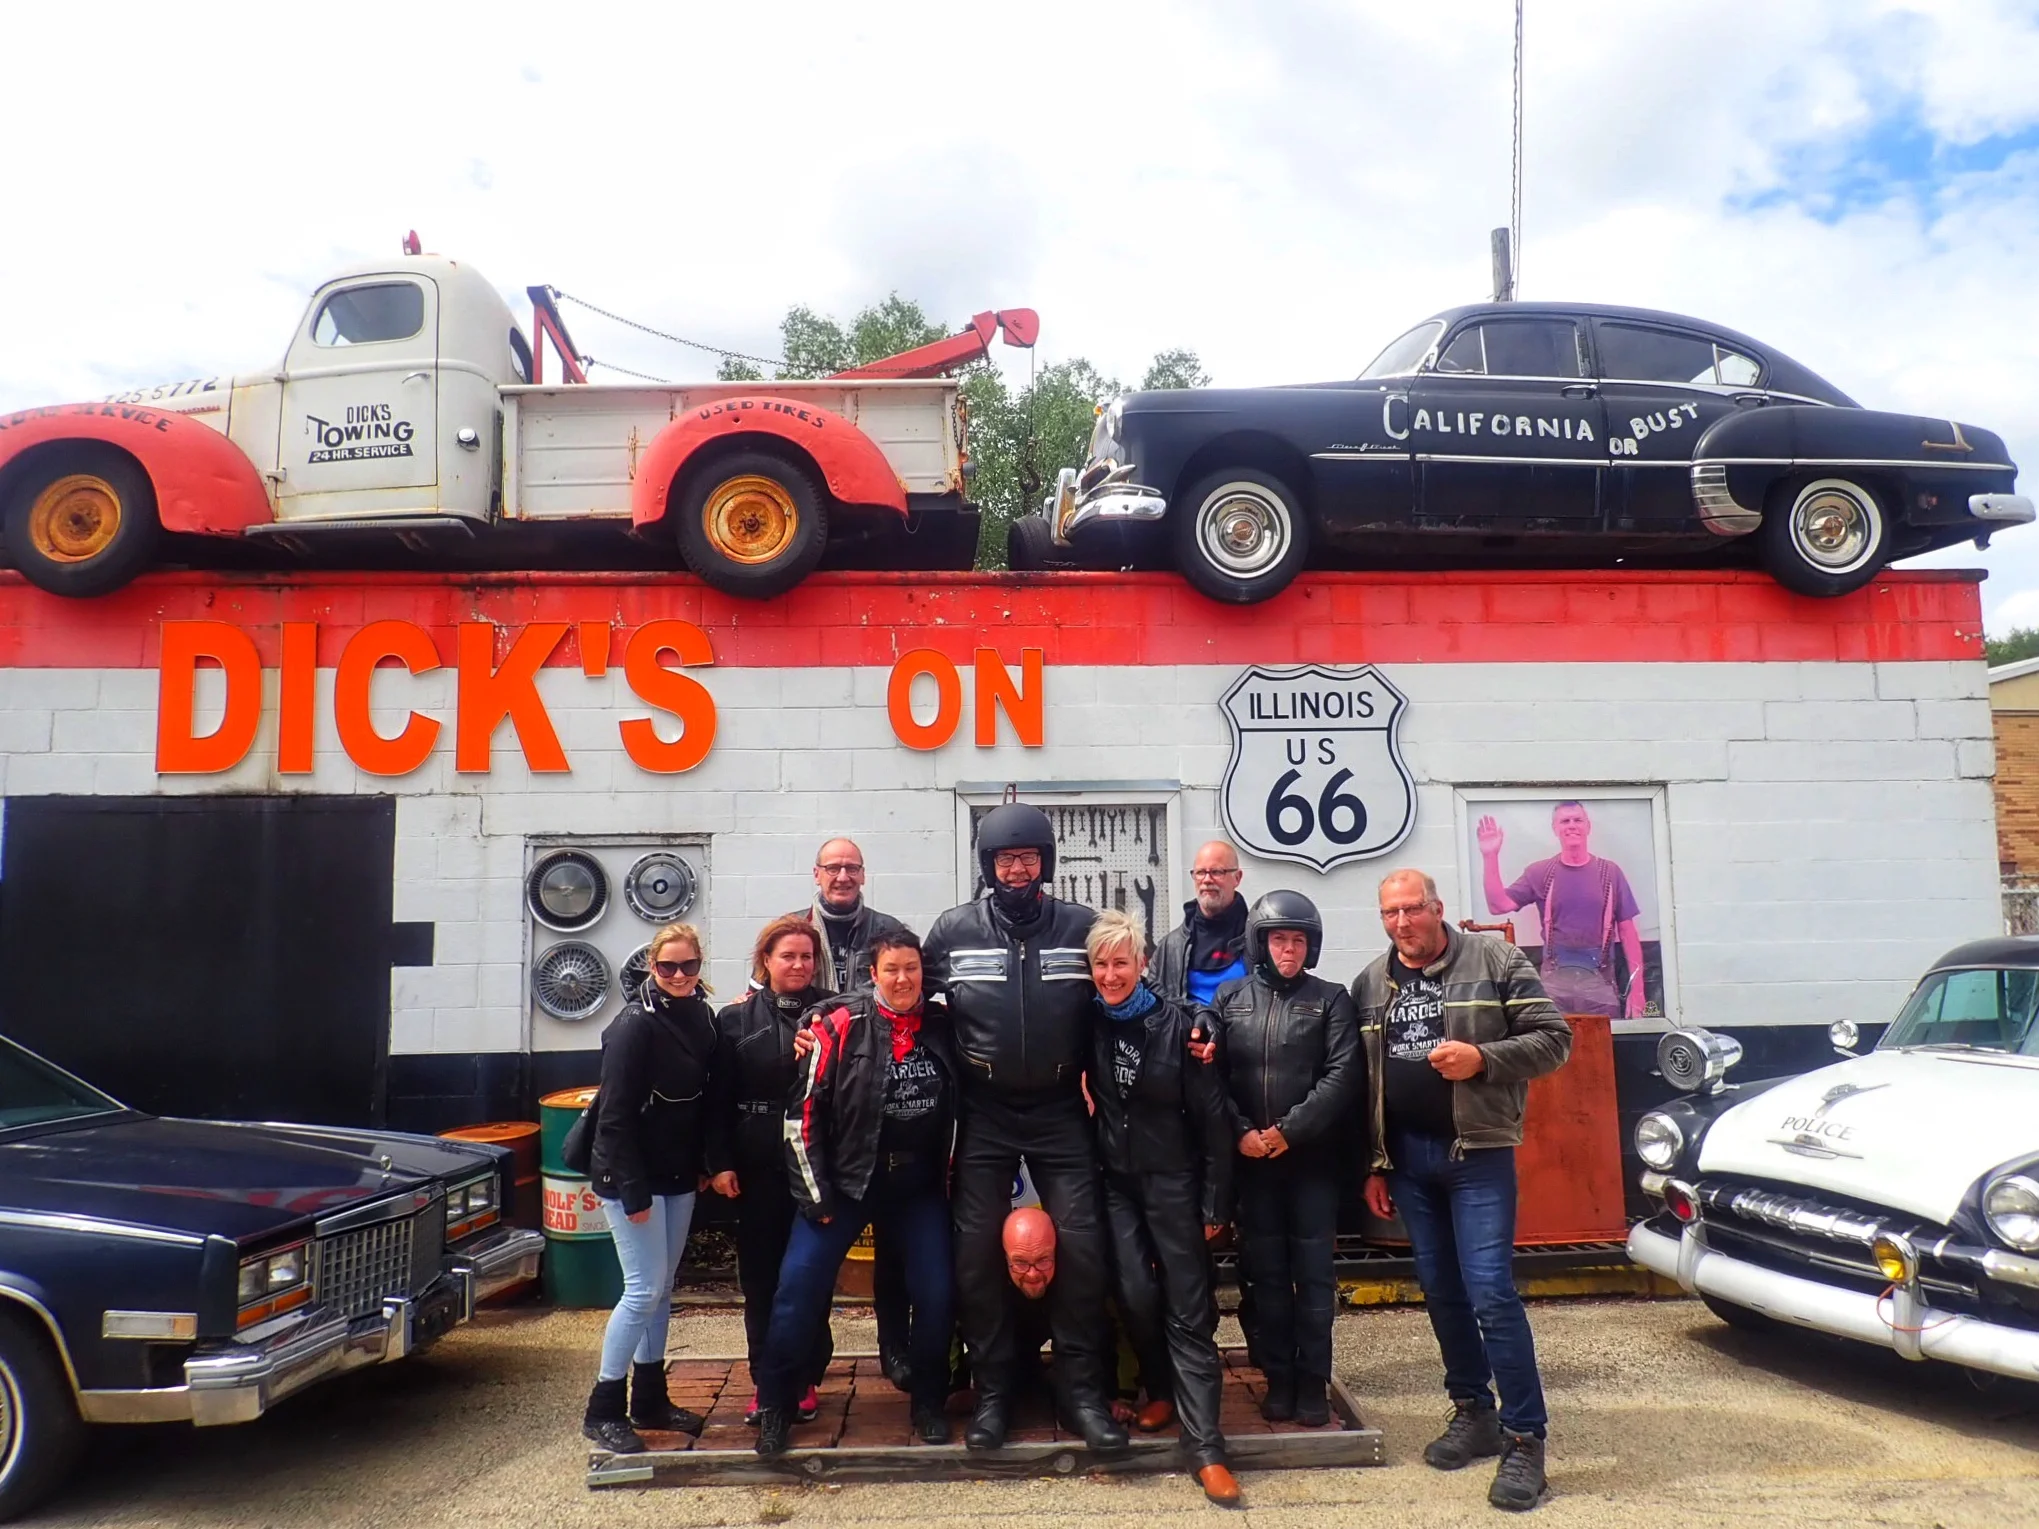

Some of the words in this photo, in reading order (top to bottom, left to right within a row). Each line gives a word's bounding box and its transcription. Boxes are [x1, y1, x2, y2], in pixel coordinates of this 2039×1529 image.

[151, 376, 219, 400] 5772
[346, 403, 392, 424] DICK'S
[700, 400, 754, 420] USED
[762, 401, 826, 429] TIRES
[1382, 395, 1595, 442] CALIFORNIA
[1608, 436, 1639, 456] OR
[1629, 401, 1698, 440] BUST
[306, 414, 414, 448] TOWING
[312, 451, 331, 462] 24
[332, 449, 352, 459] HR.
[353, 444, 407, 457] SERVICE
[155, 619, 717, 776] DICK'S
[887, 648, 1044, 750] ON
[1249, 690, 1375, 720] ILLINOIS
[1265, 767, 1368, 846] 66
[889, 1059, 937, 1080] ARDER
[884, 1102, 900, 1111] ORK
[901, 1098, 935, 1109] SMARTER
[1780, 1116, 1858, 1141] POLICE
